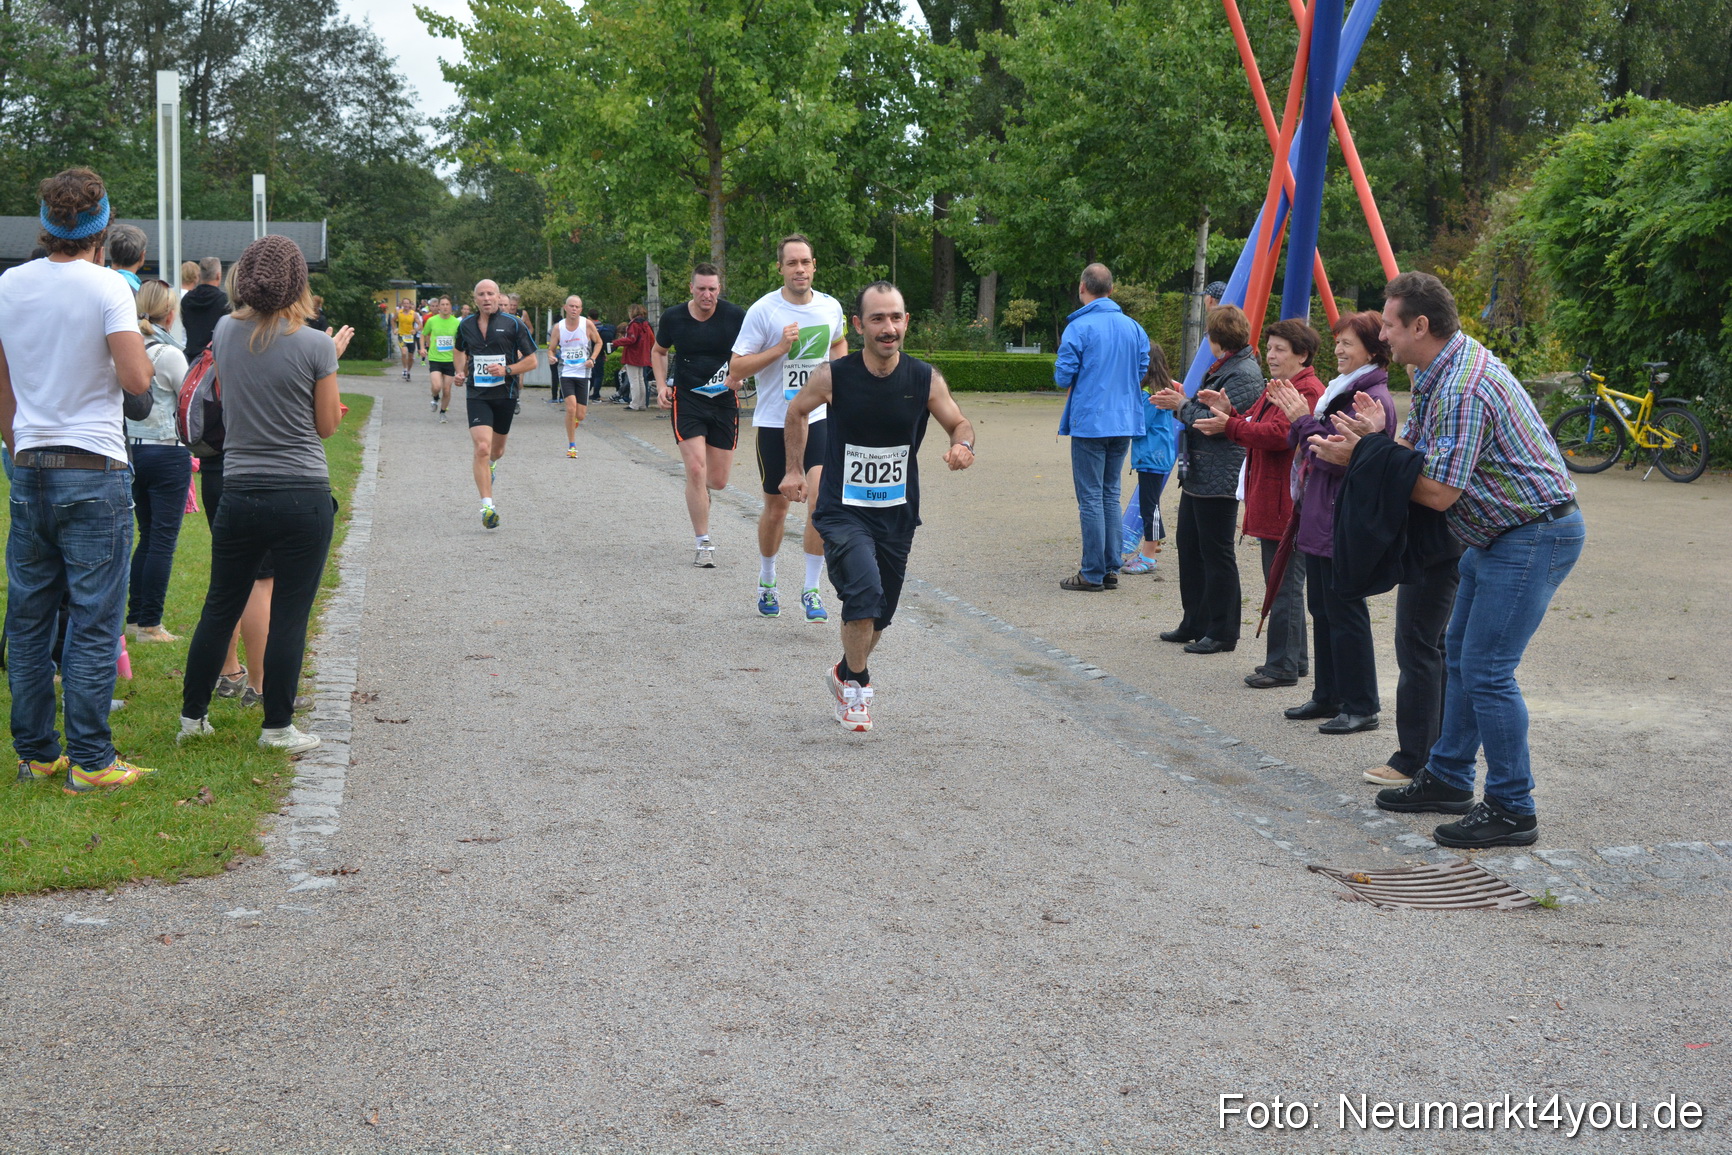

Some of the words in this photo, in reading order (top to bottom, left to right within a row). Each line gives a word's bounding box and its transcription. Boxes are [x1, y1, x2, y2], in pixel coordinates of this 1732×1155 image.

[566, 351, 583, 359] 2759
[28, 454, 66, 467] PMA
[868, 452, 899, 460] Neumarkt
[850, 460, 902, 484] 2025
[866, 490, 887, 500] Eyup
